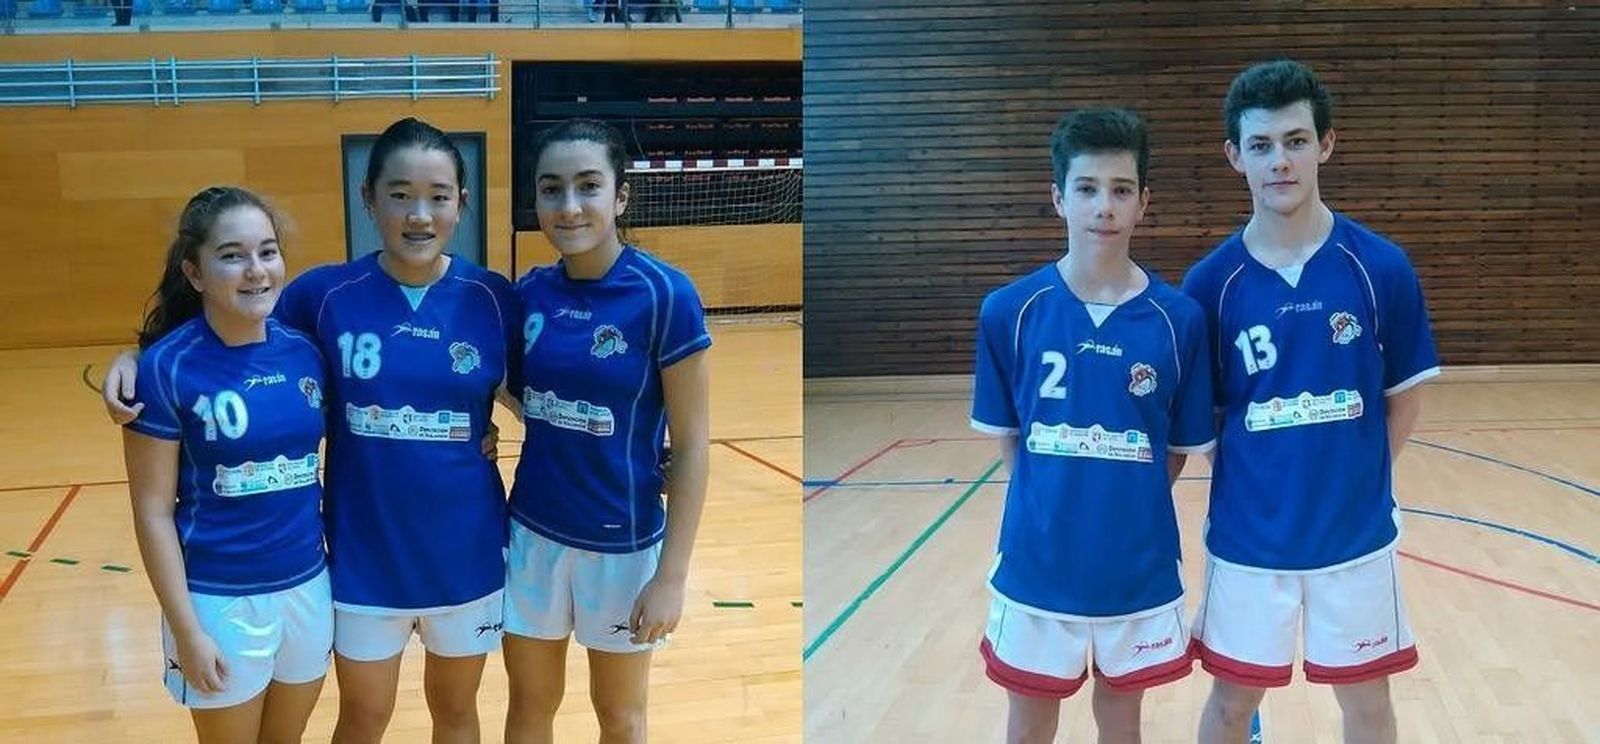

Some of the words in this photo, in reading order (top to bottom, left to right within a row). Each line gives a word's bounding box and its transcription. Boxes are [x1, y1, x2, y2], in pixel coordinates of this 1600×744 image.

[337, 331, 382, 379] 18
[1039, 350, 1067, 400] 2
[1234, 324, 1277, 376] 13
[192, 389, 249, 441] 10
